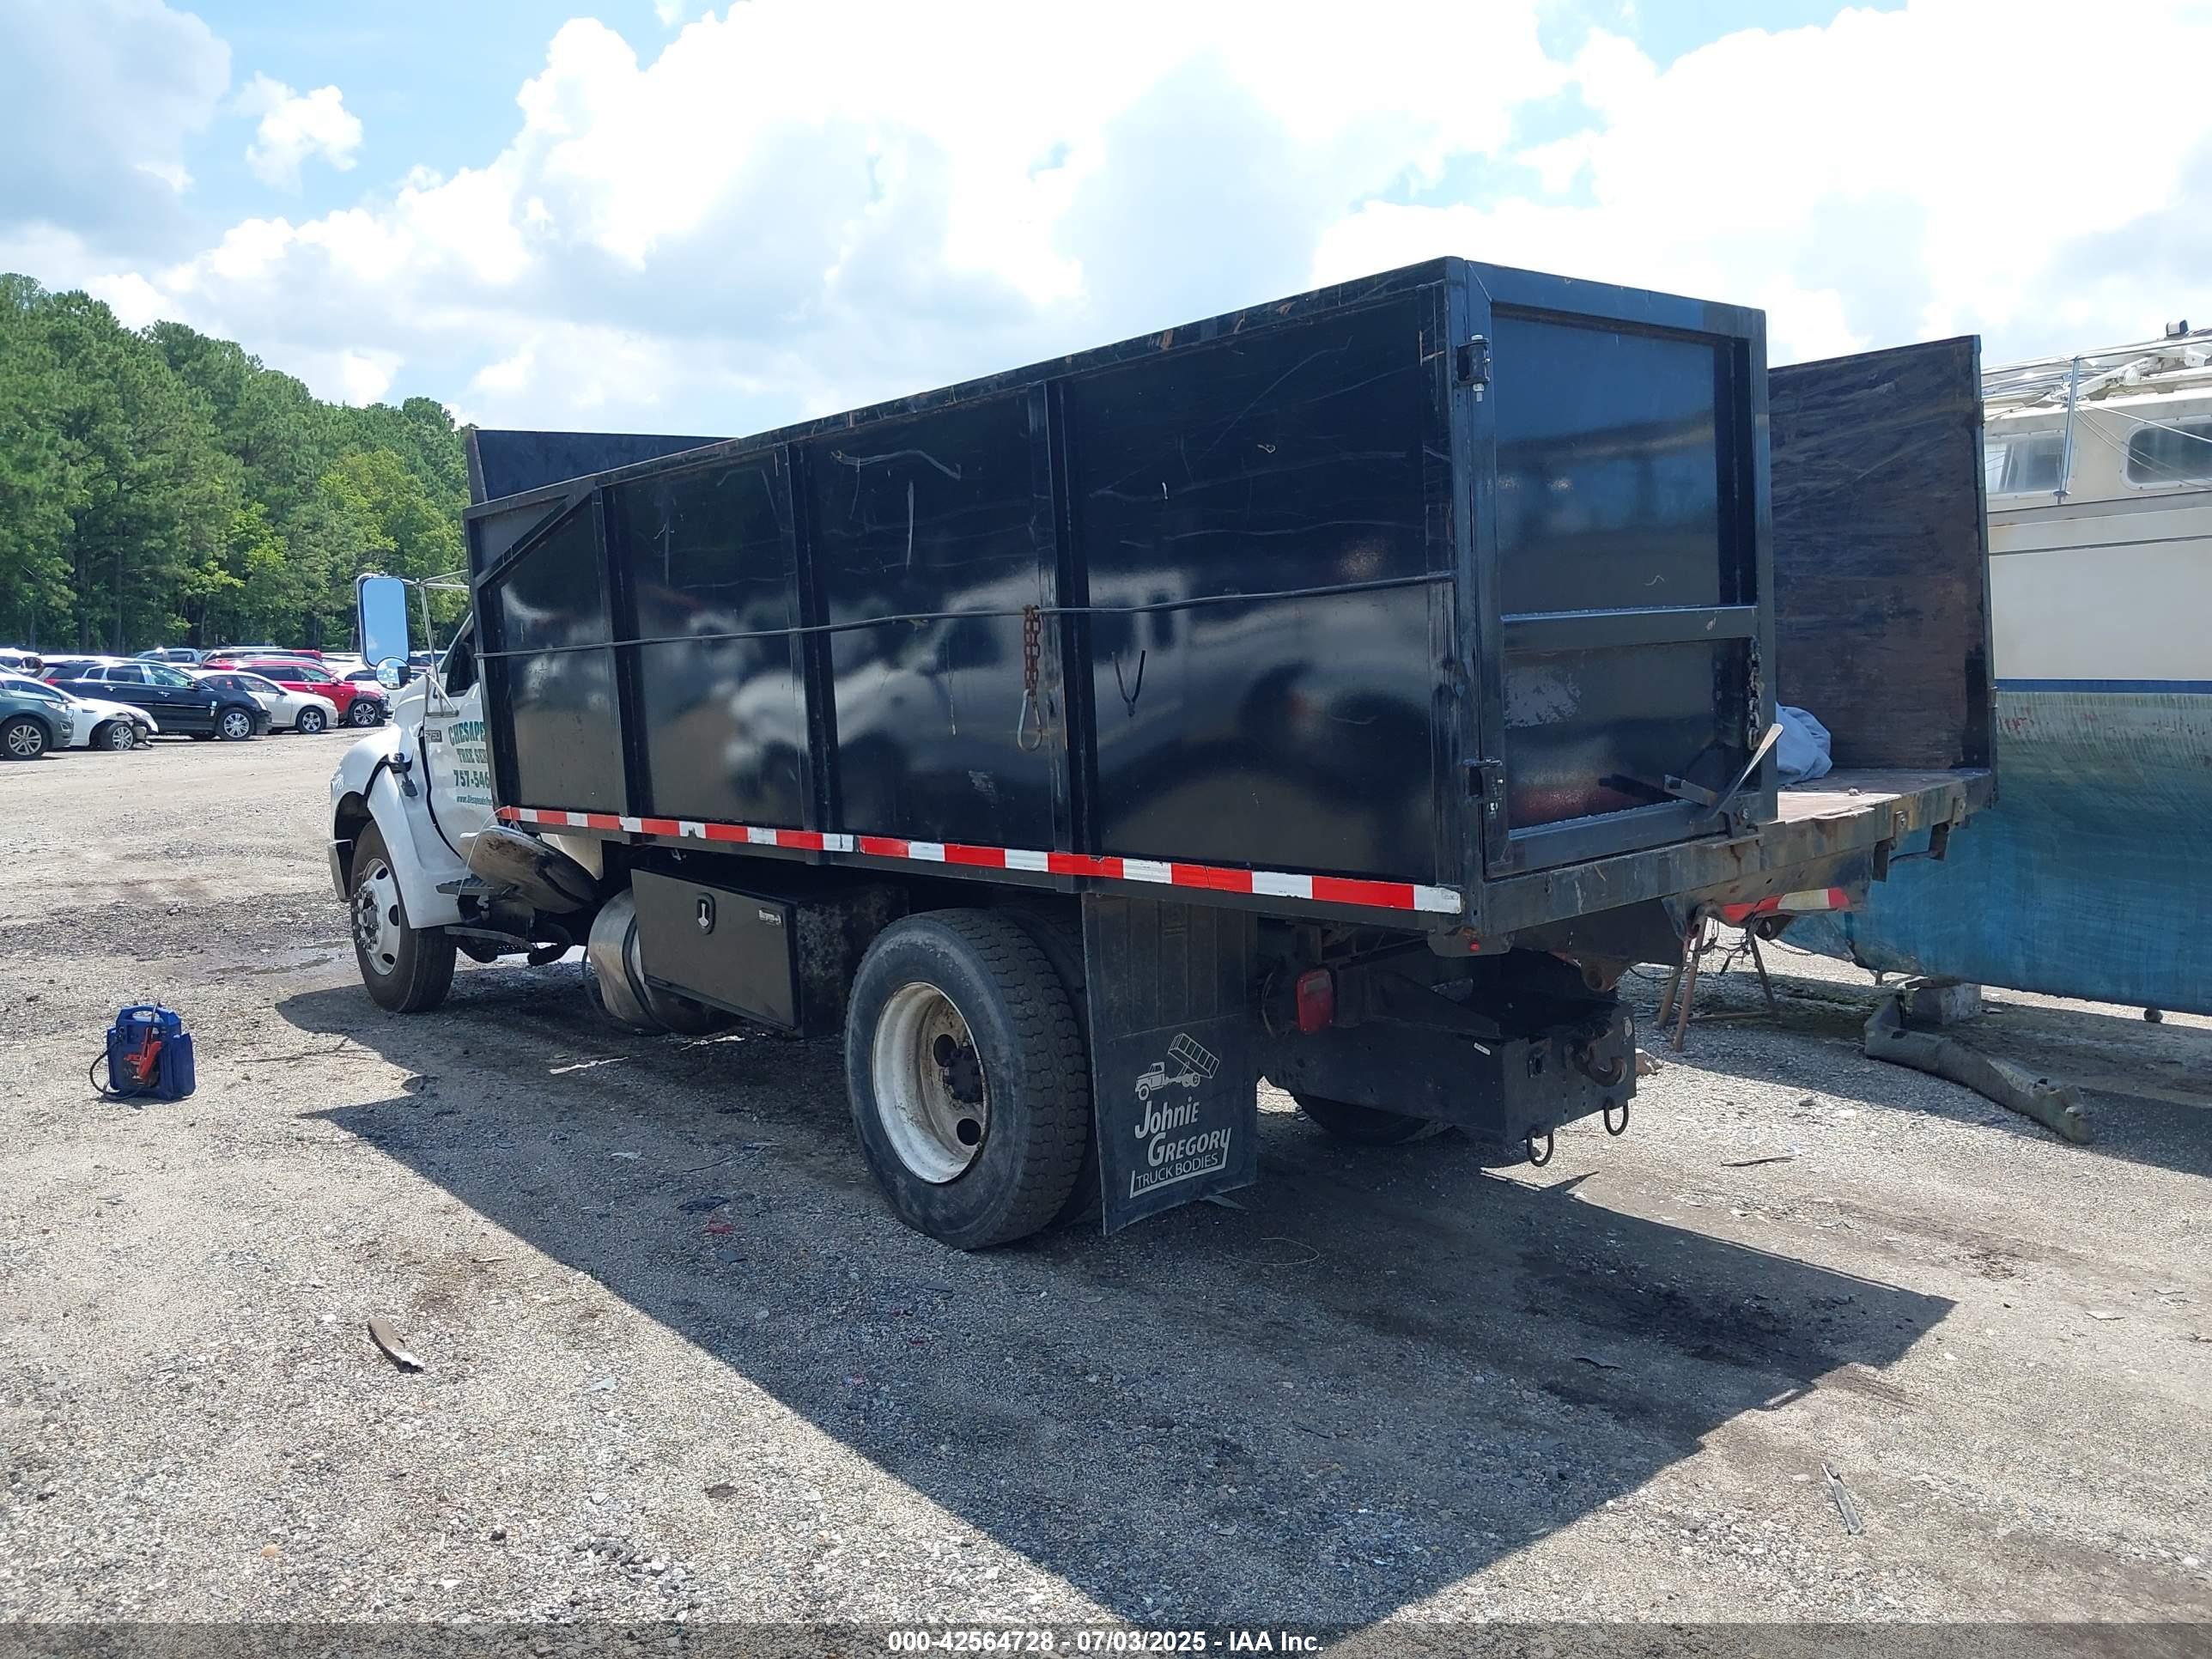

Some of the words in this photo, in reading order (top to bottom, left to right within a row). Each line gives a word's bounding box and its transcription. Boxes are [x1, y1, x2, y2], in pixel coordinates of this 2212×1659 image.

[456, 749, 476, 763] TREE
[1136, 1165, 1174, 1188] TRUCK
[1175, 1152, 1218, 1176] BODIES
